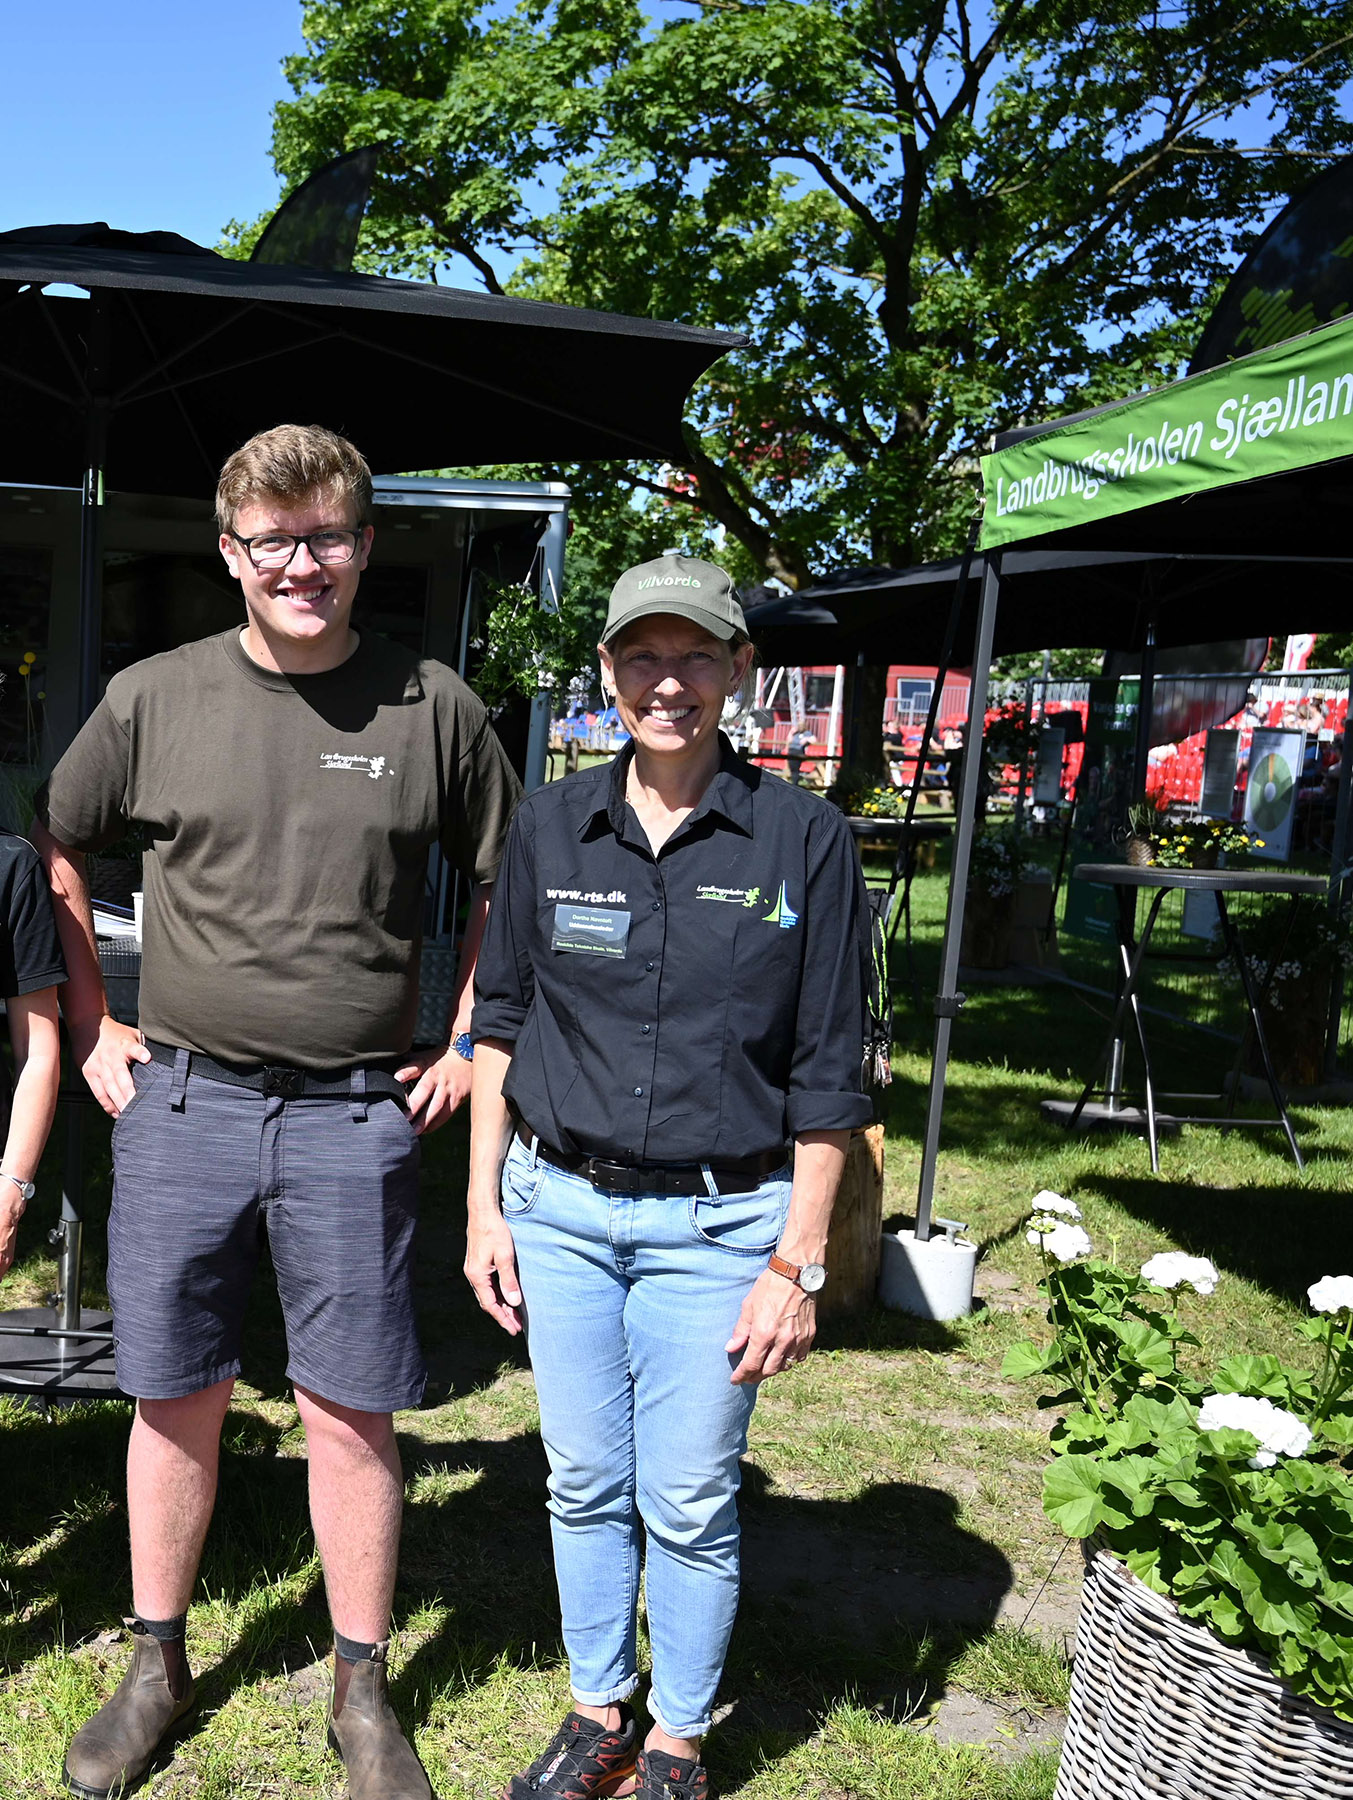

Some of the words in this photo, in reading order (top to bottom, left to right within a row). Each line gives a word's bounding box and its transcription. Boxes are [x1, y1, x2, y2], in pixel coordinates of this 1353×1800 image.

[995, 420, 1204, 516] Landbrugsskolen
[1210, 373, 1353, 459] Sjællan
[546, 889, 627, 904] www.rts.dk
